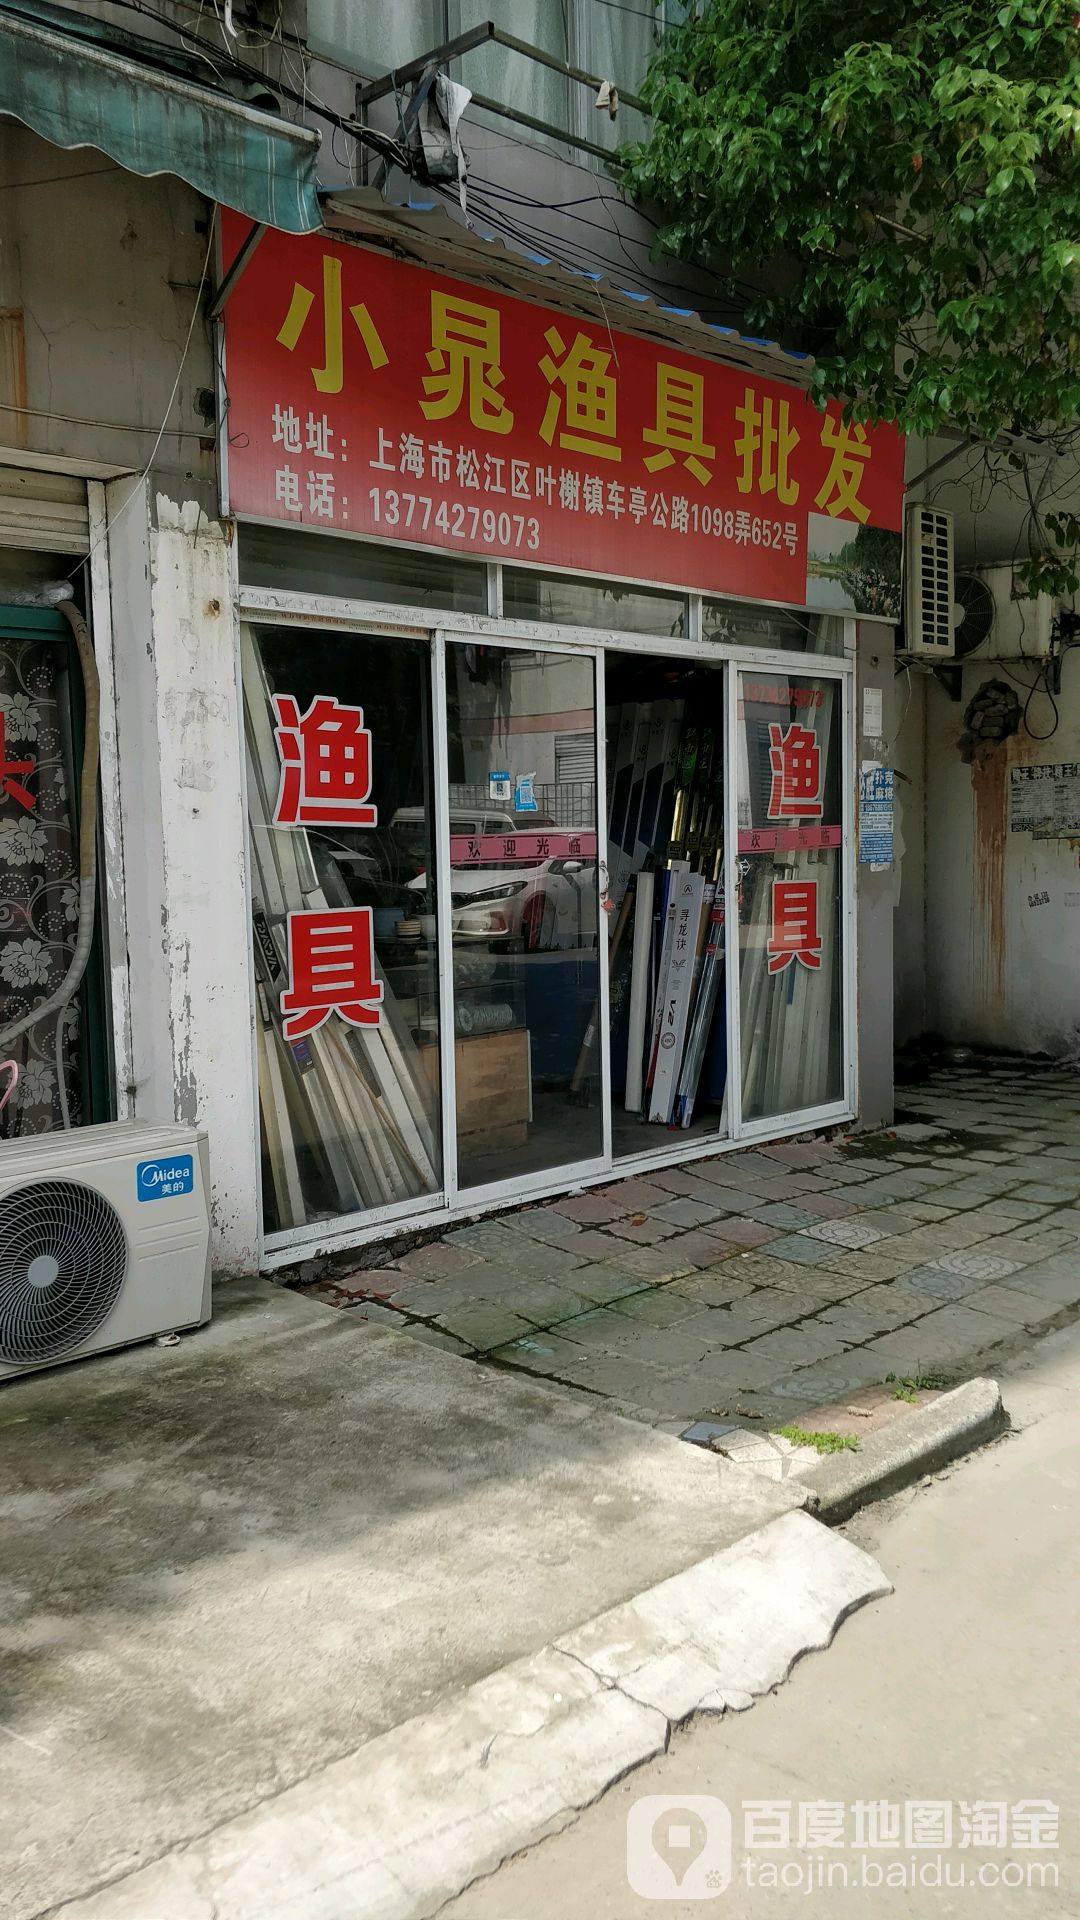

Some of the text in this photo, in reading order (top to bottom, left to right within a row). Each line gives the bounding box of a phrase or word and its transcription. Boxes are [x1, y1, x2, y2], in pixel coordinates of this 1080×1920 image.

[276, 254, 873, 523] 小晁渔具批发
[272, 693, 385, 1042] 渔具
[467, 837, 581, 858] 欢迎光临
[767, 722, 823, 976] 渔具
[144, 1166, 190, 1184] Midea
[162, 1181, 184, 1195] 美的
